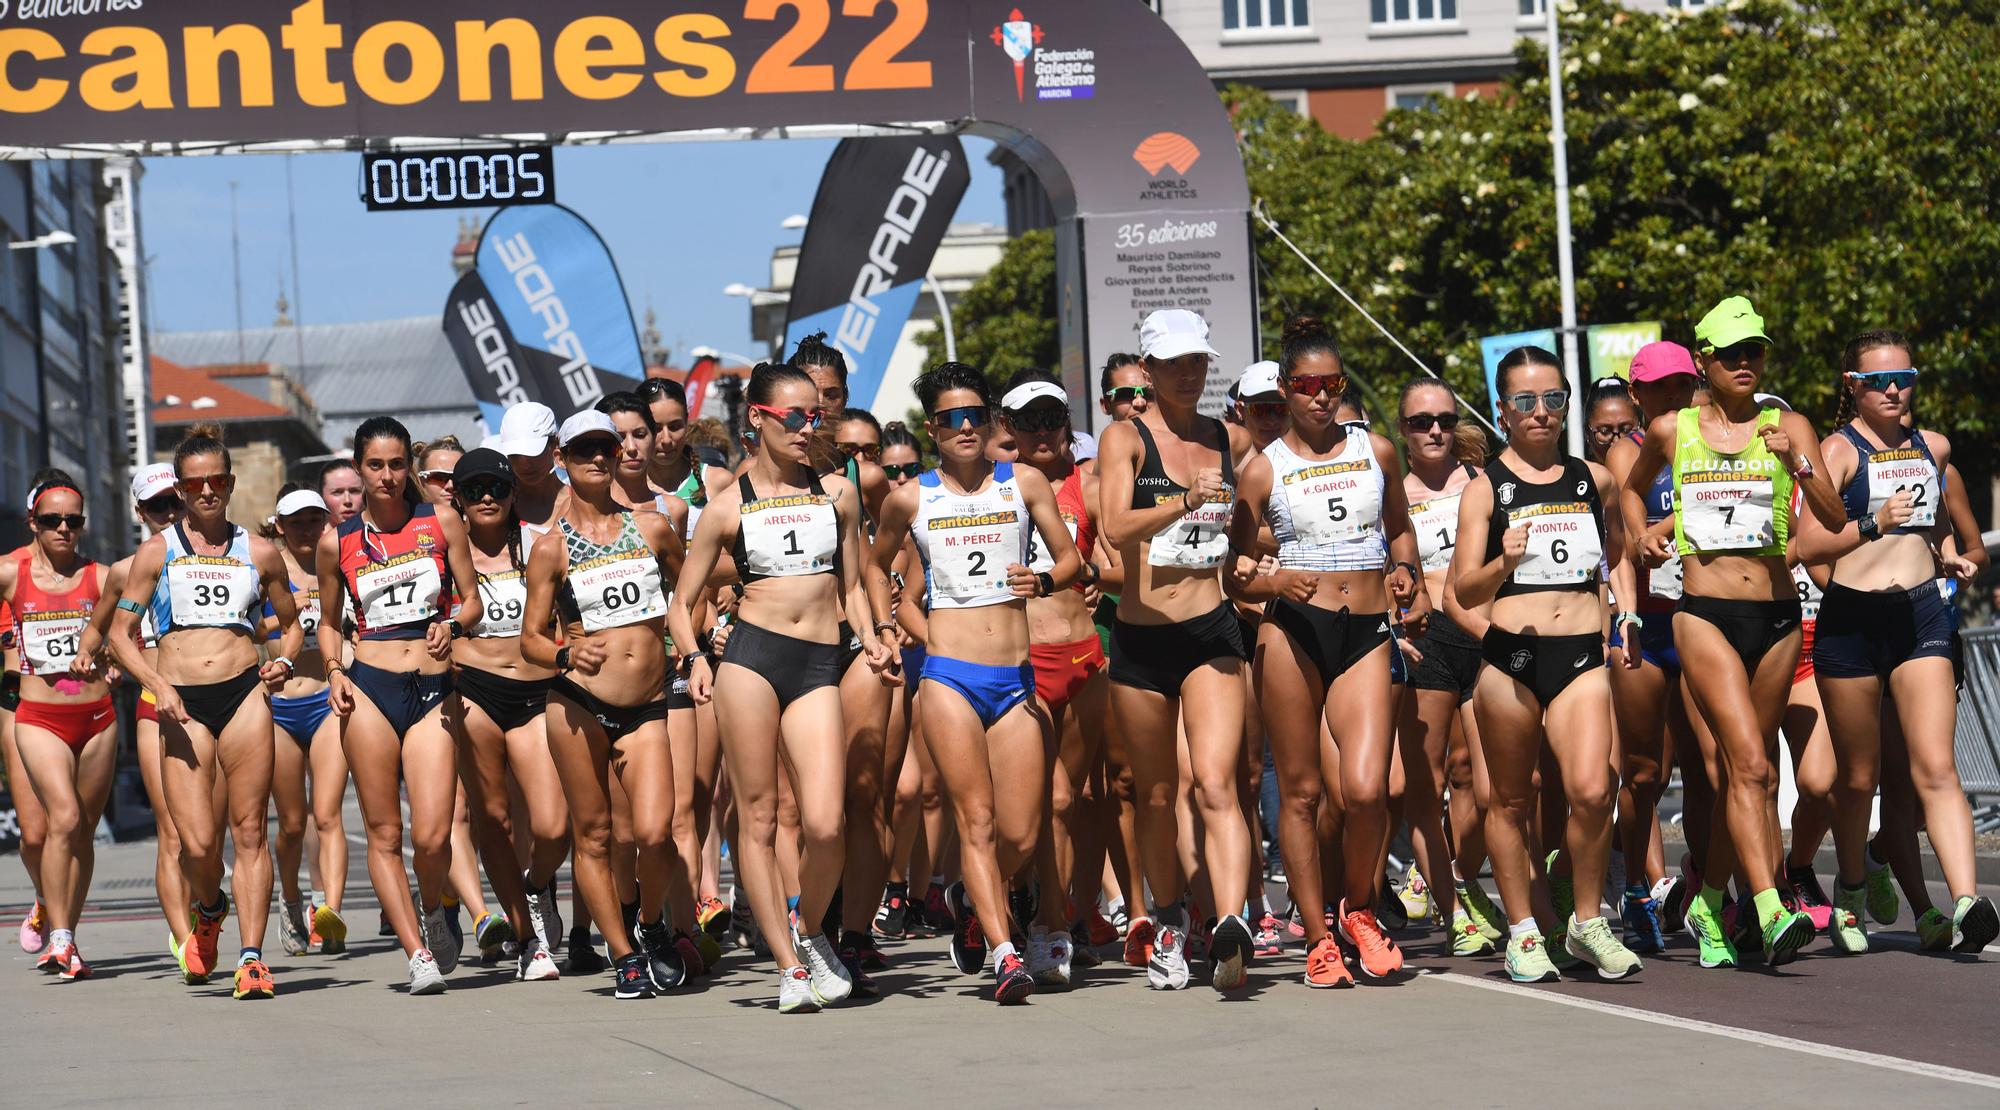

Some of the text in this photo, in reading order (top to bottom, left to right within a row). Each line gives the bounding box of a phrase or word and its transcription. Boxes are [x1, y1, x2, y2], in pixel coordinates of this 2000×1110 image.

[1034, 48, 1094, 62] Federación
[1035, 62, 1095, 76] Galega de
[1036, 75, 1096, 88] Atletismo
[372, 153, 544, 203] 00:00:05
[1148, 180, 1188, 190] WORLD
[1140, 190, 1198, 200] ATHLETICS
[1115, 220, 1218, 248] 35 ediciones
[1116, 250, 1221, 263] Maurizio Damilano
[1128, 262, 1211, 274] Reyes Sobrino
[1104, 272, 1235, 287] Giovanni de Benedictis
[1133, 285, 1208, 297] Beate Anders
[1131, 296, 1211, 308] Ernesto Canto
[1680, 459, 1777, 473] ECUADOR
[1877, 467, 1930, 480] HENDERSO
[147, 471, 176, 484] CHIN
[1138, 477, 1170, 487] OYSHO
[741, 496, 829, 514] cantones22
[1328, 497, 1348, 522] 5
[1510, 502, 1589, 520] cantones22
[764, 513, 811, 526] ARENAS
[929, 512, 1015, 529] cantones22
[1719, 506, 1735, 529] 7
[1532, 521, 1578, 534] MONTAG
[783, 530, 804, 556] 1
[945, 537, 960, 547] M.
[1184, 525, 1201, 549] 4
[1551, 539, 1569, 564] 6
[357, 547, 430, 577] canones22
[967, 550, 987, 576] 2
[186, 571, 232, 580] STEVENS
[373, 569, 417, 587] ESCARIZ
[582, 564, 646, 586] HERIQUES
[194, 584, 230, 606] 39
[383, 581, 417, 608] 17
[602, 581, 641, 610] 60
[487, 598, 522, 622] 69
[36, 625, 81, 637] OLIVEIRA
[46, 636, 78, 657] 61
